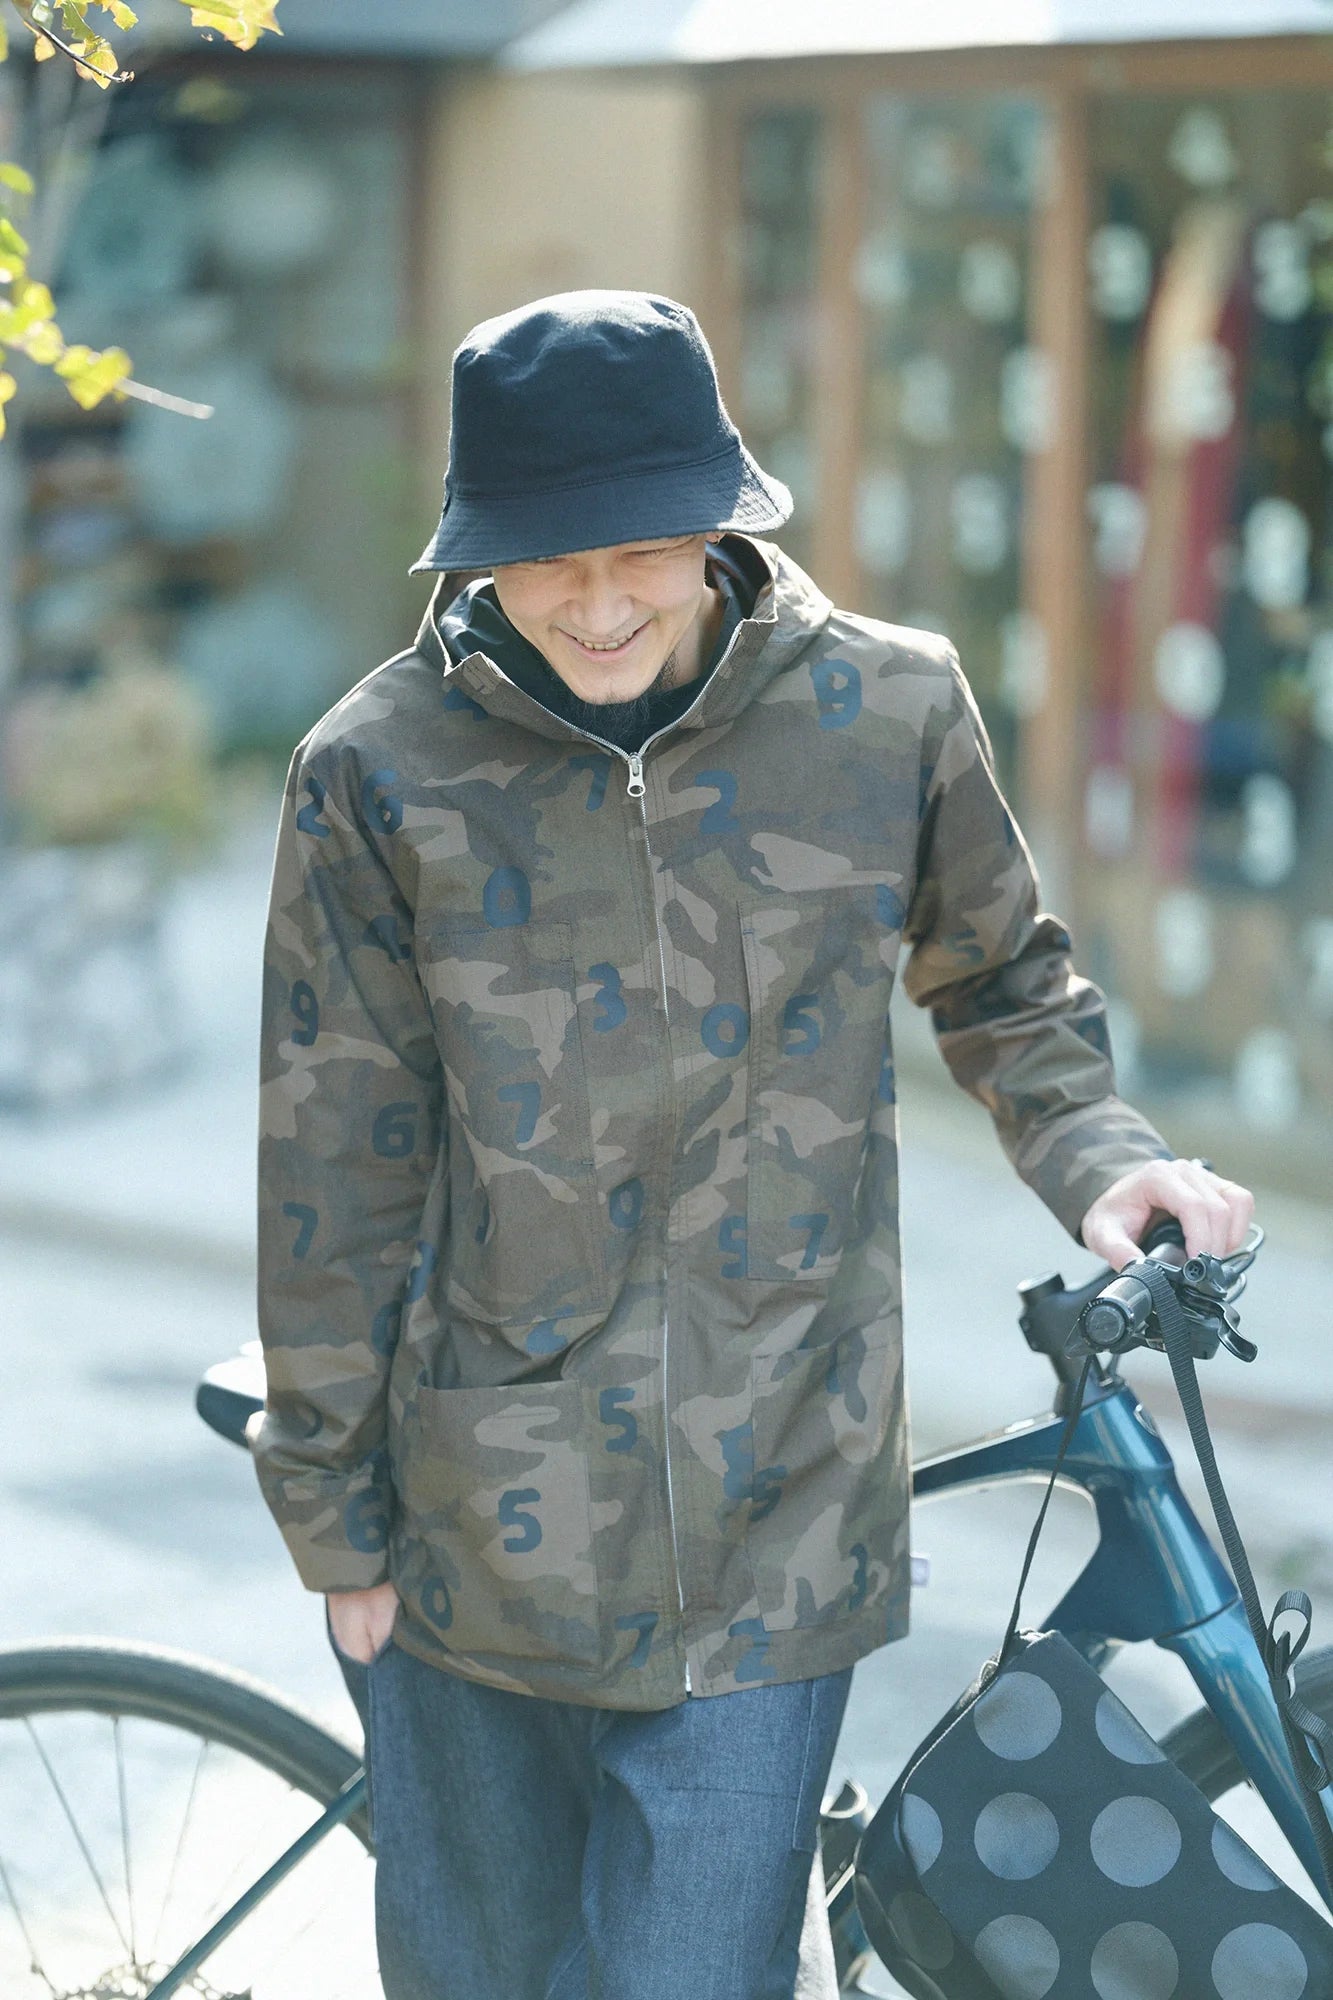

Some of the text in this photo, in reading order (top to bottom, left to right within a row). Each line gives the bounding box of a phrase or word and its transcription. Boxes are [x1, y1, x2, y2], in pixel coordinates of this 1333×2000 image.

[811, 659, 862, 731] 9
[297, 776, 331, 838] 2
[362, 769, 403, 835] 6
[567, 754, 612, 812] 7
[694, 770, 740, 834] 2
[483, 866, 532, 928] 0
[290, 979, 318, 1047] 9
[587, 961, 628, 1034] 3
[783, 994, 821, 1057] 5
[701, 1002, 749, 1059] 0
[372, 1102, 418, 1158] 6
[497, 1081, 541, 1144] 7
[282, 1202, 319, 1259] 7
[788, 1213, 829, 1270] 7
[599, 1387, 637, 1454] 5
[344, 1487, 390, 1554] 6
[498, 1488, 543, 1554] 5
[420, 1576, 454, 1630] 0
[615, 1611, 658, 1669] 7
[728, 1618, 777, 1684] 2
